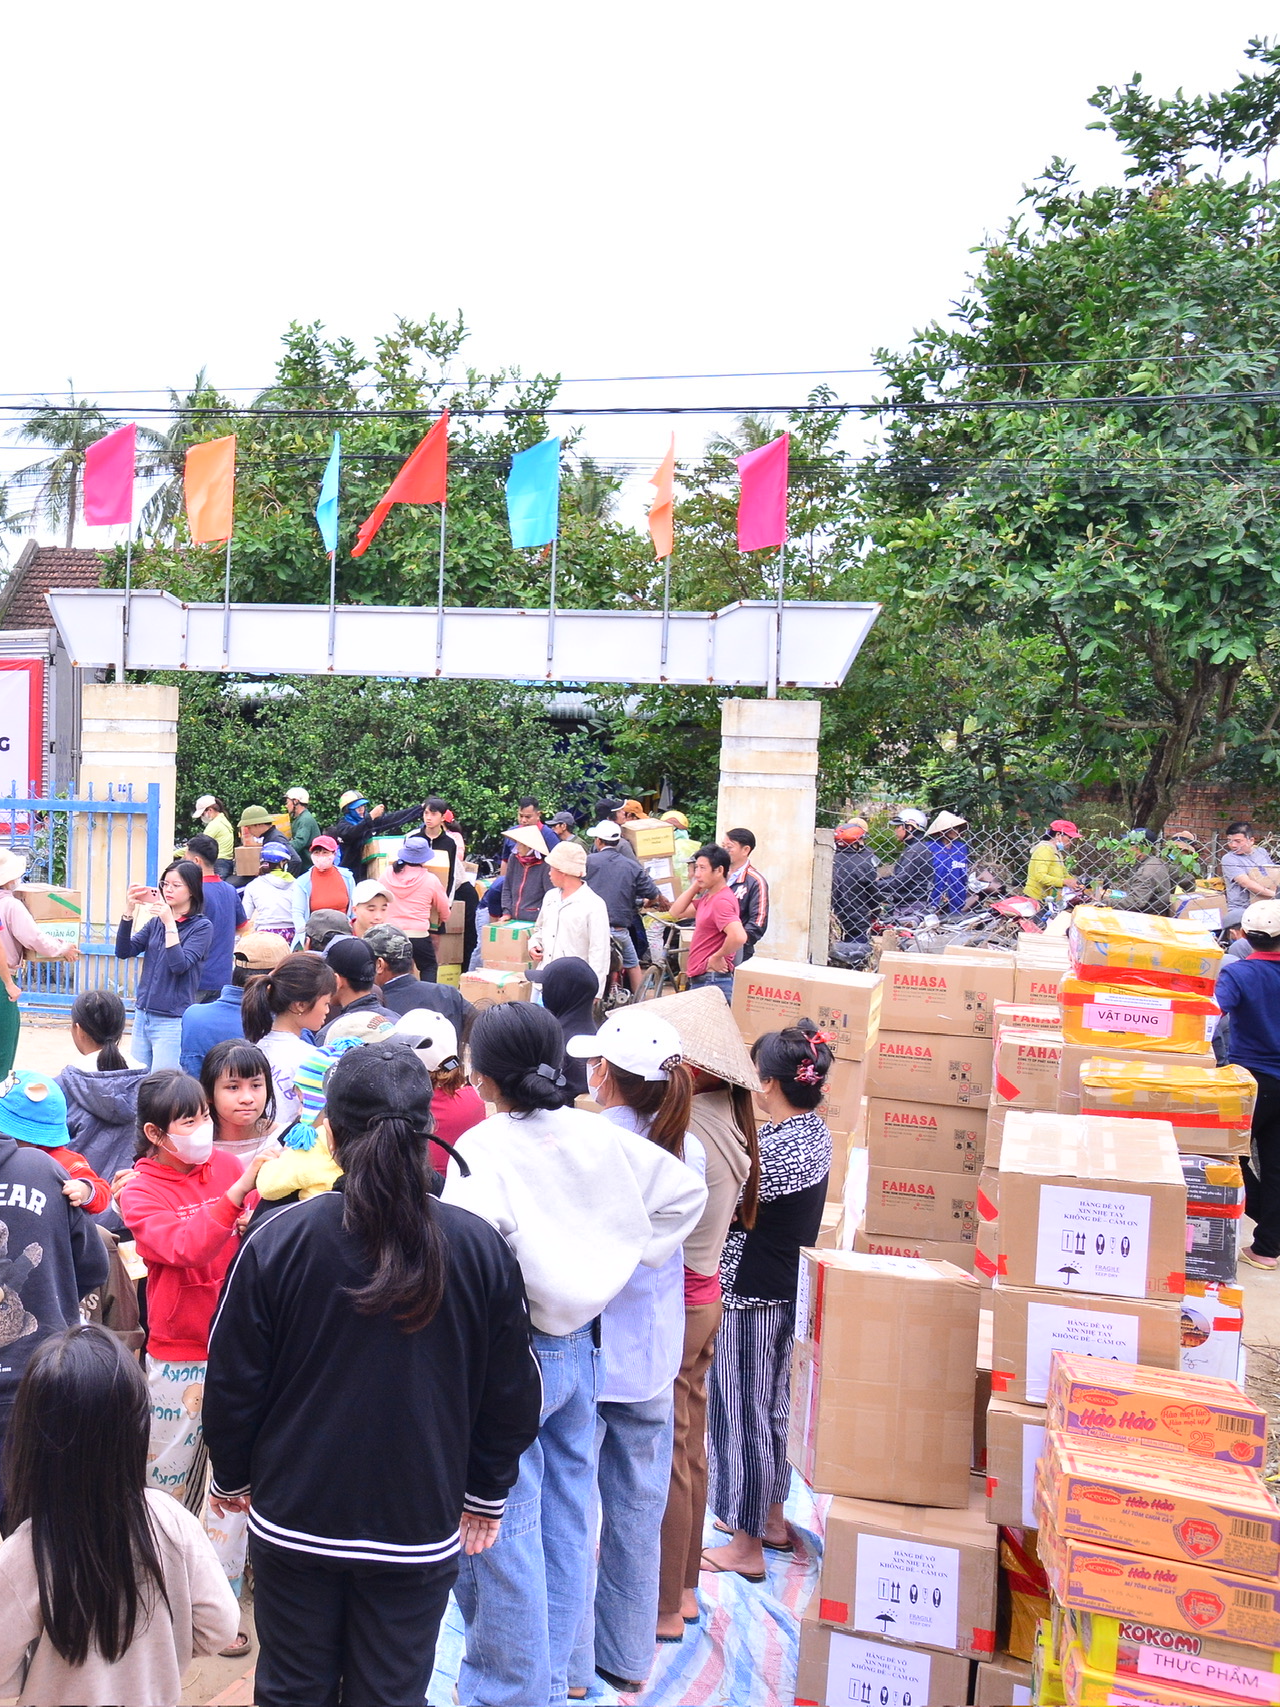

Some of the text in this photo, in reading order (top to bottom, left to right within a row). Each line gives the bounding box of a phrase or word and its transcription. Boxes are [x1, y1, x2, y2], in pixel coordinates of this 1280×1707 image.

[893, 974, 947, 988] FAHASA
[1030, 982, 1058, 995] FAH
[748, 984, 802, 1002] FAHASA
[1098, 1009, 1159, 1025] VẬT DỤNG
[879, 1043, 932, 1058] FAHASA
[1018, 1045, 1061, 1060] FAHA
[884, 1112, 937, 1127] FAHASA
[882, 1180, 935, 1195] FAHASA
[868, 1243, 920, 1259] FAHASA
[1095, 1264, 1120, 1273] FRAGILE
[162, 1364, 206, 1382] LUCKY
[152, 1405, 182, 1421] LUC
[1079, 1407, 1157, 1431] Hảo Hảo
[1188, 1430, 1215, 1451] 25
[152, 1467, 187, 1486] UCKY
[1125, 1496, 1175, 1511] Hảo Hảo
[1128, 1567, 1178, 1583] Hảo Hảo
[909, 1613, 932, 1622] FRAGILE
[1119, 1623, 1200, 1654] KOKOMI
[1154, 1653, 1260, 1688] THỰC PHẨM
